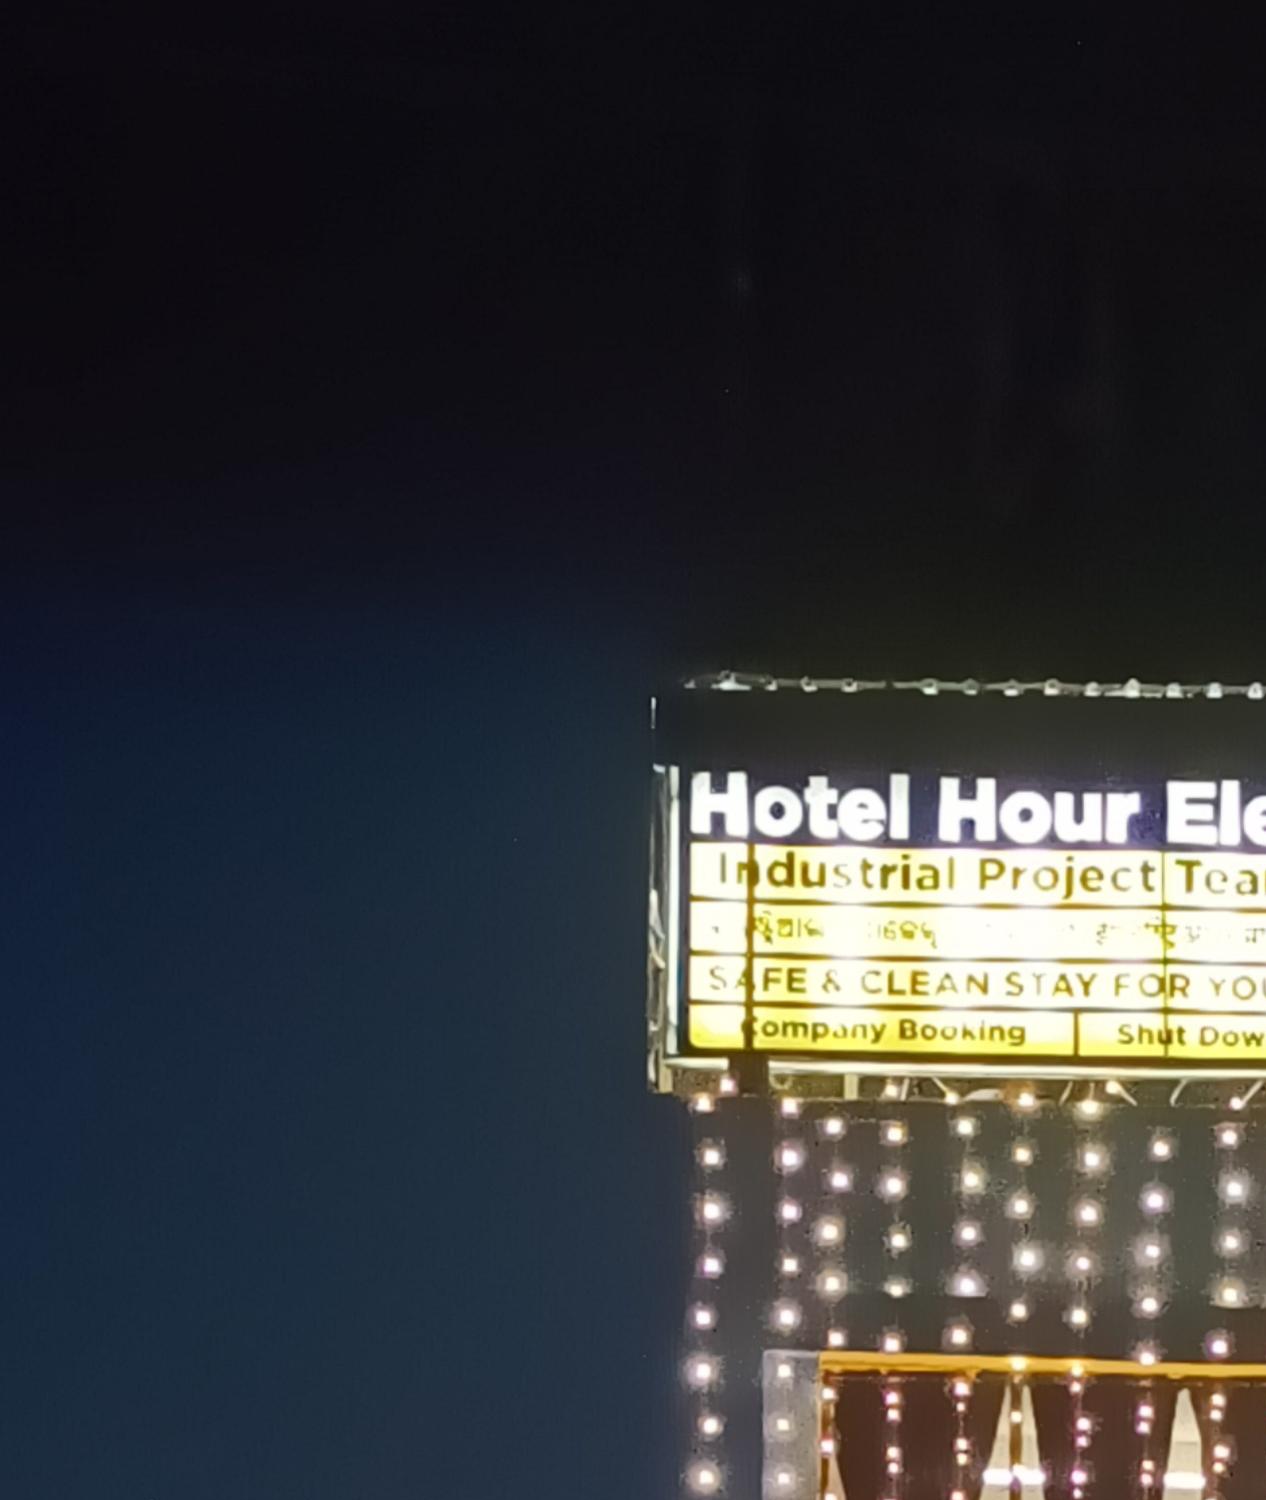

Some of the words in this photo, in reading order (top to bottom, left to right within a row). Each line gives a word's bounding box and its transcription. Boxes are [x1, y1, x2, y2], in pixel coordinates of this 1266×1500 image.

[690, 771, 910, 841] Hotel
[938, 776, 1141, 844] Hour
[720, 851, 956, 892] Industrial
[979, 855, 1157, 900] Project
[709, 965, 807, 994] SAFE
[821, 970, 841, 993] &
[861, 970, 990, 997] CLEAN
[1005, 972, 1098, 998] STAY
[1114, 973, 1191, 1000] FOR
[741, 1017, 887, 1043] Company
[899, 1018, 1026, 1046] Booking
[1118, 1024, 1186, 1046] Shut
